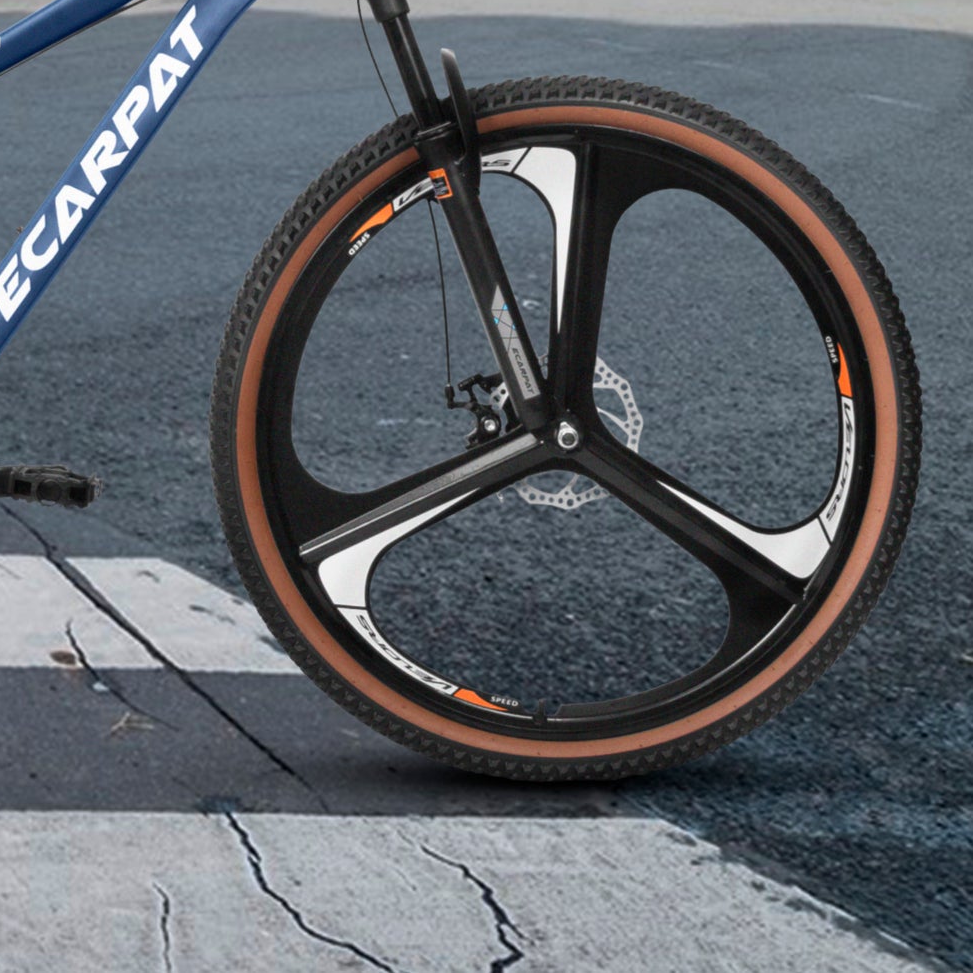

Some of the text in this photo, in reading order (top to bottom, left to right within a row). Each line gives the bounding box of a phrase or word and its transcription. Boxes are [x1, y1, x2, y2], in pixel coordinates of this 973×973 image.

[348, 232, 371, 256] SPEED
[825, 335, 838, 364] SPEED
[512, 347, 535, 395] ECARPAT
[826, 402, 853, 522] VELORS
[357, 615, 453, 691] VELORS
[491, 695, 519, 707] SPEED
